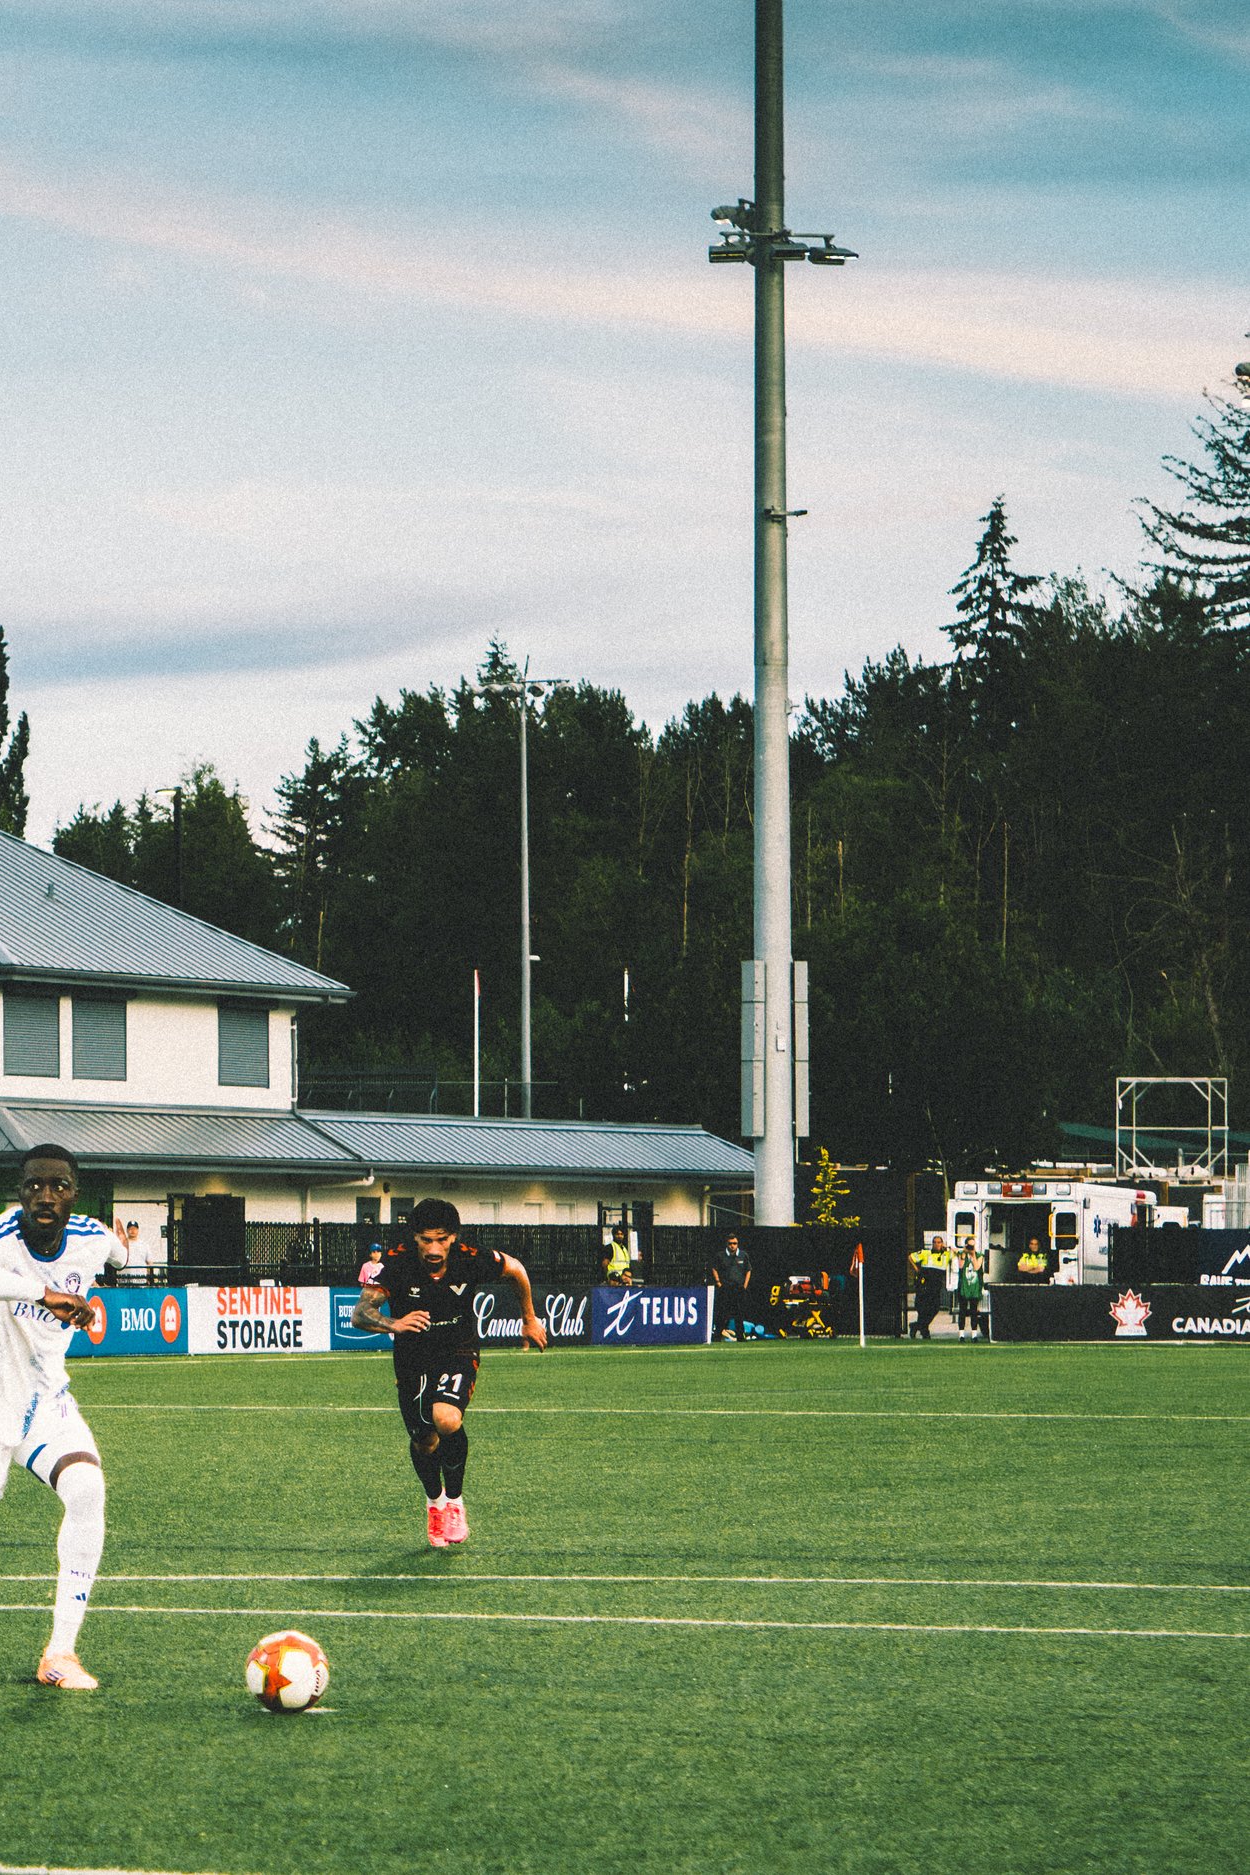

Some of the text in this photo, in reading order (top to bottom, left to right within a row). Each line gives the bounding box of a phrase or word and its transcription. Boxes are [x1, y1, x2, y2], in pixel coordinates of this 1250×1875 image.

[13, 1301, 57, 1324] BMO
[216, 1286, 303, 1316] SENTINEL
[640, 1296, 699, 1326] TELUS
[120, 1307, 157, 1332] BMO
[216, 1319, 303, 1350] STORAGE
[435, 1372, 463, 1393] 21
